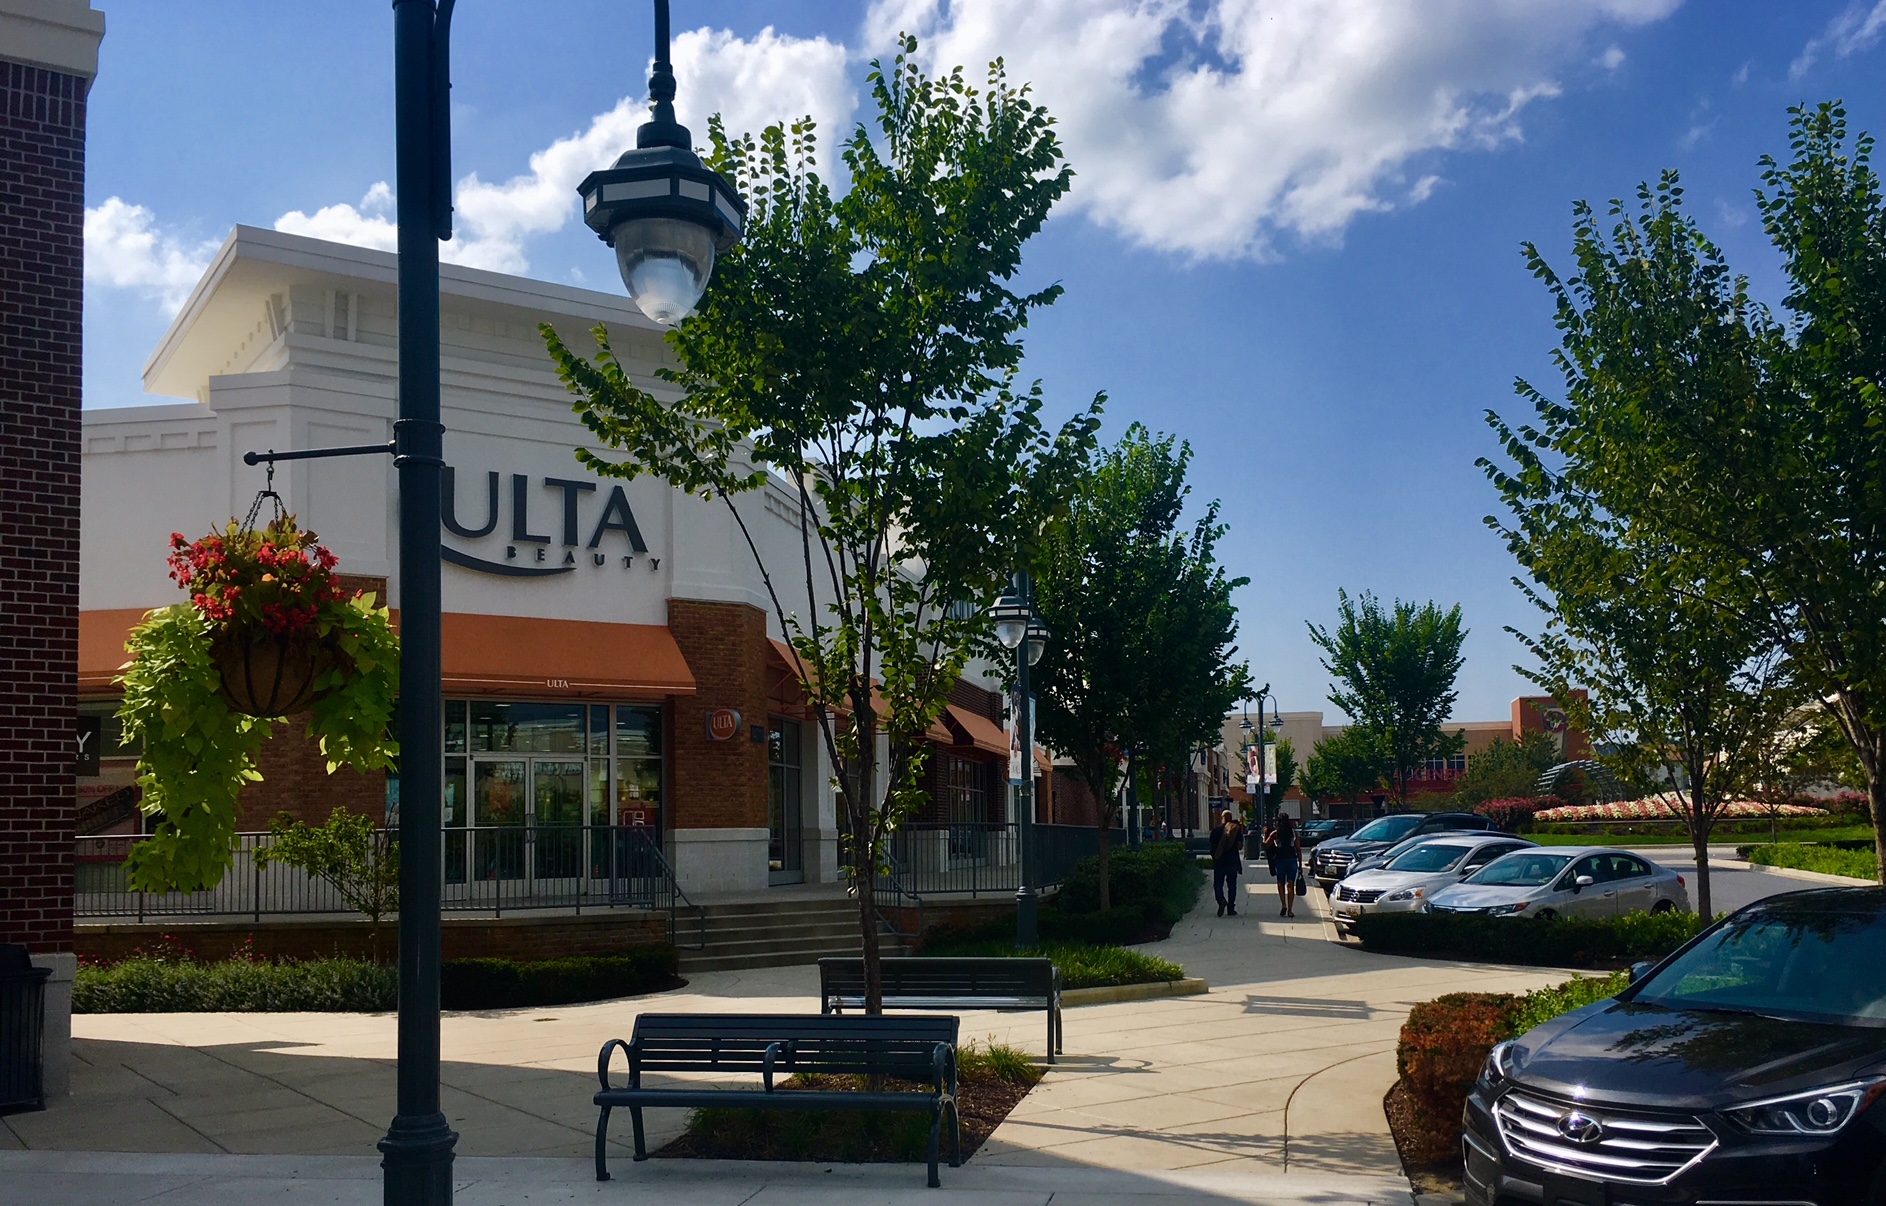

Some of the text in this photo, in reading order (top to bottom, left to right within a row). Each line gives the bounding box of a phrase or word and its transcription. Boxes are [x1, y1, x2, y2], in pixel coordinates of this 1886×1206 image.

[441, 466, 649, 553] ULTA
[506, 545, 661, 571] BEAUTY
[546, 679, 569, 689] ULTA
[713, 714, 733, 730] ULTA
[1414, 768, 1467, 782] CINEM
[97, 784, 113, 793] OFF
